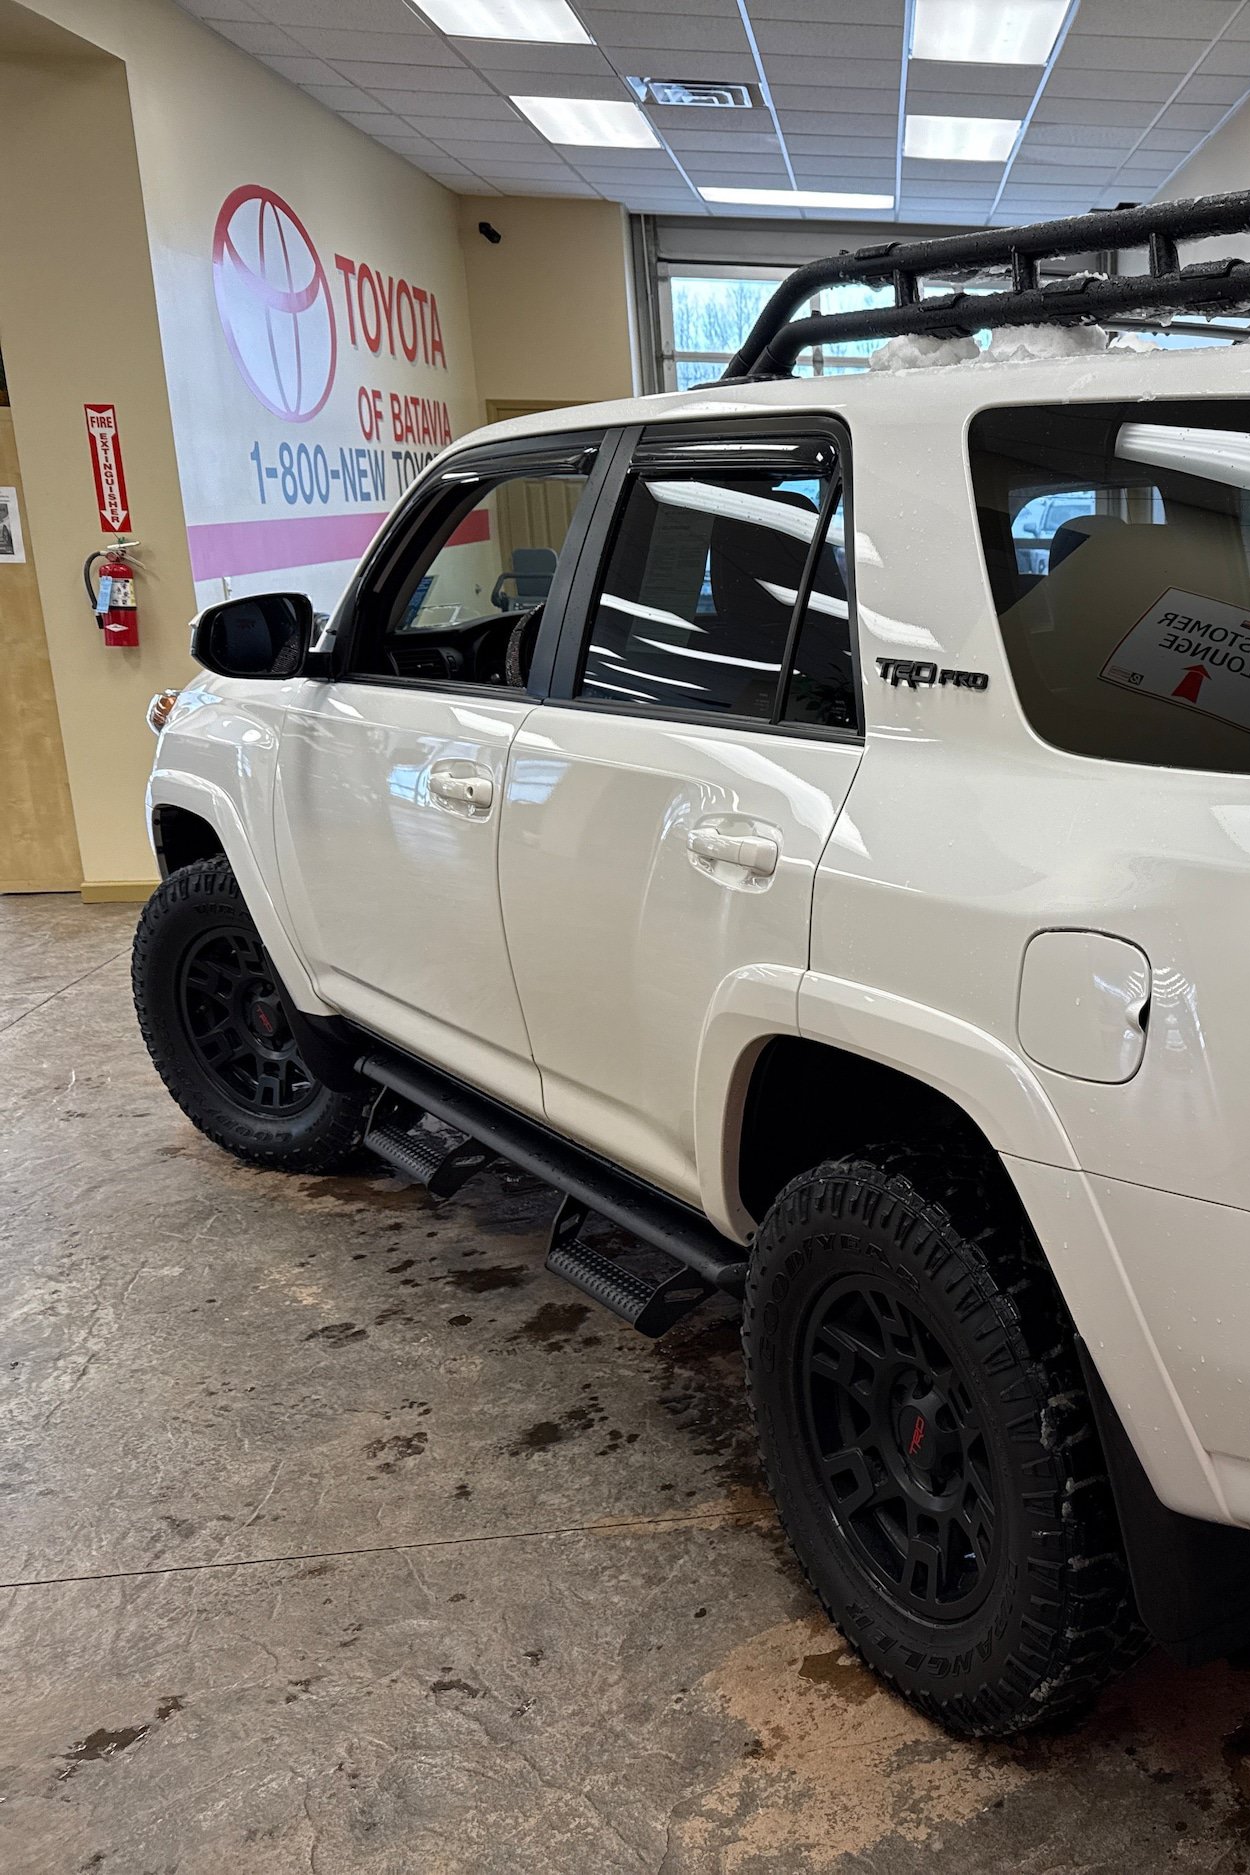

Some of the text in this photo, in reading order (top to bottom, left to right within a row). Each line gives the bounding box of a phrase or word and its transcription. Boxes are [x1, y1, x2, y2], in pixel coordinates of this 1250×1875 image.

[334, 253, 447, 369] TOYOTA
[90, 416, 113, 428] FIRE
[358, 386, 452, 446] OF BATAVIA
[99, 433, 120, 523] EXTINGUISHER
[250, 440, 386, 505] 1-800-NEW
[875, 657, 989, 690] TRD PRO
[908, 1415, 926, 1456] TRD
